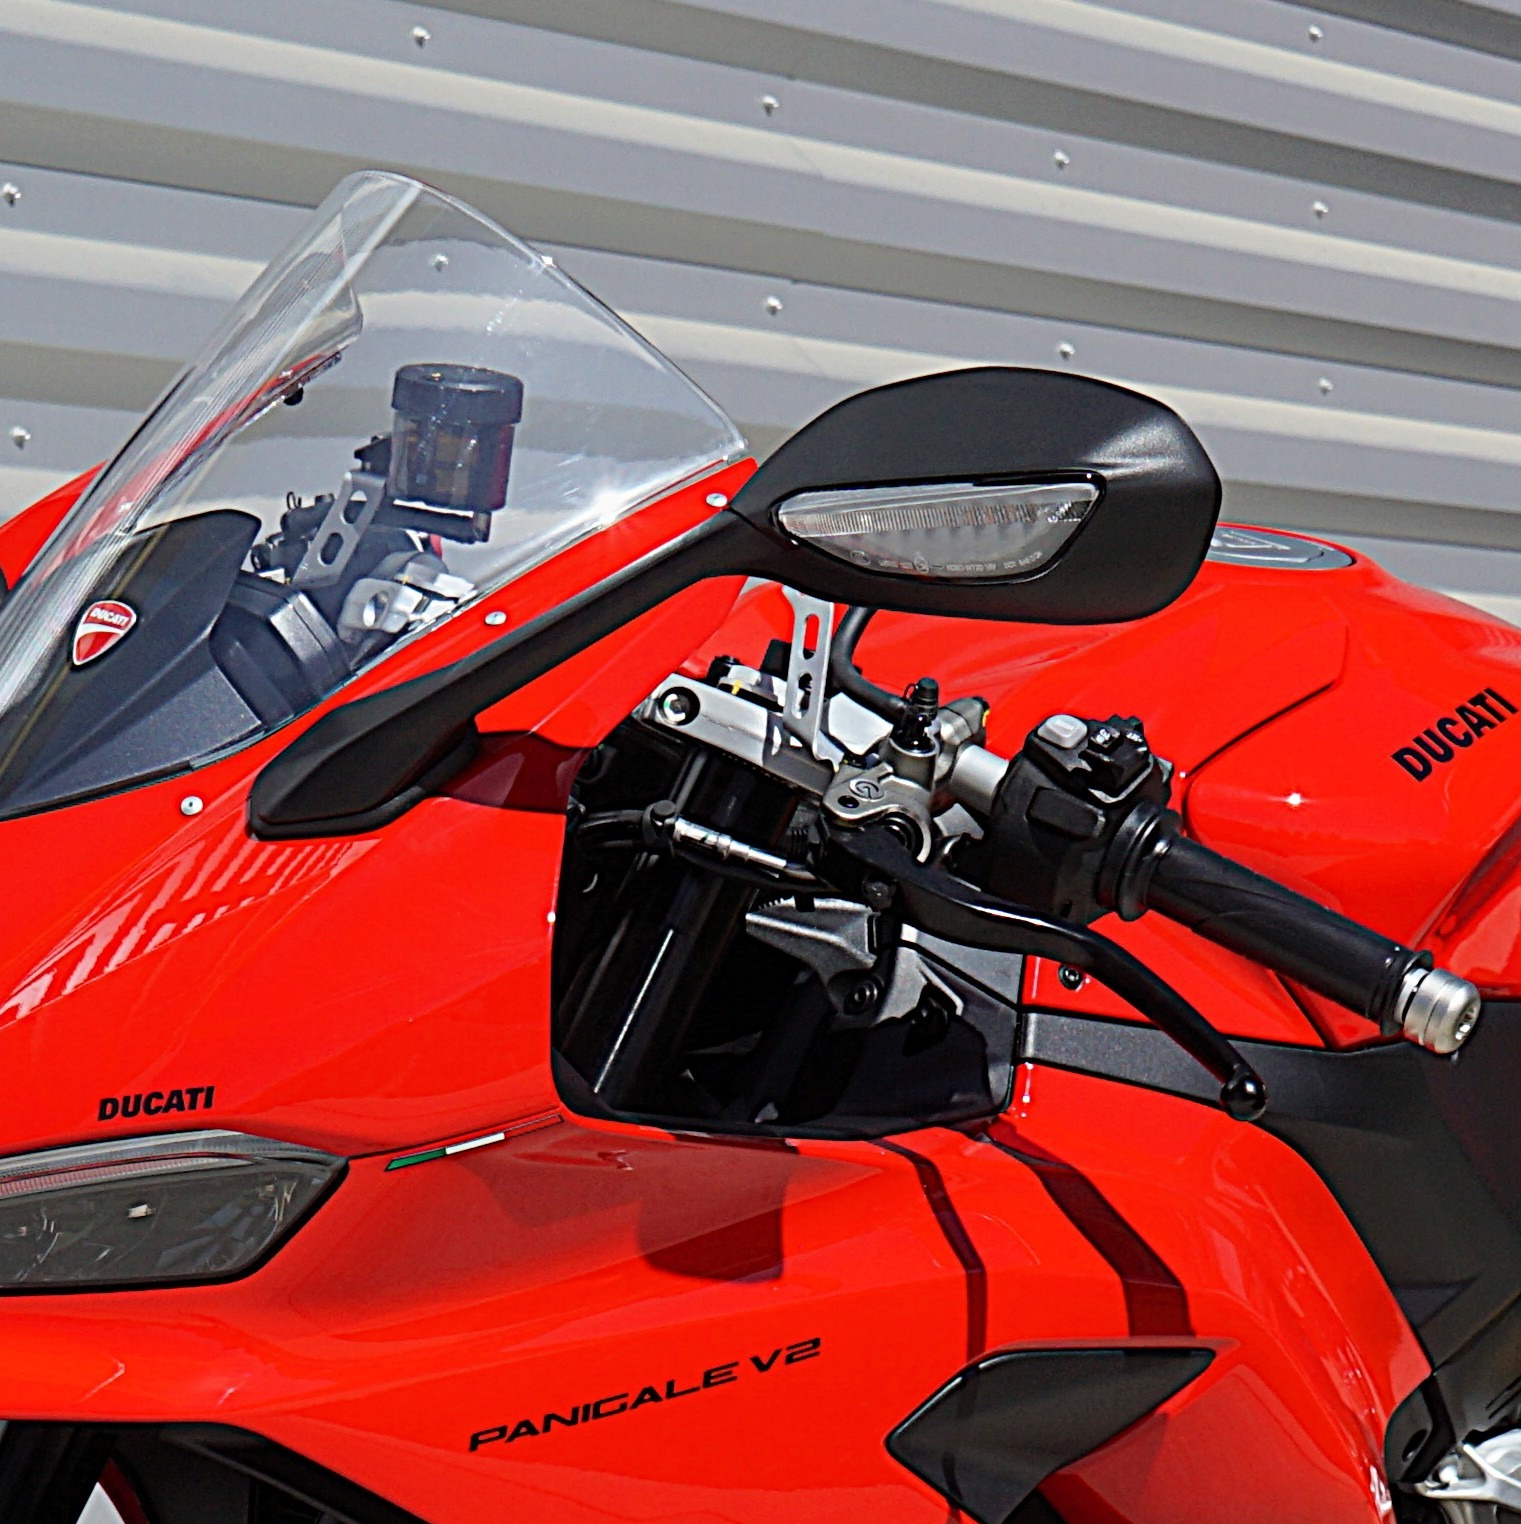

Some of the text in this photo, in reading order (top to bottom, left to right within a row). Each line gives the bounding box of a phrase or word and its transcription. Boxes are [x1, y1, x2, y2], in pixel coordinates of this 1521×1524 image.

[90, 607, 130, 626] DUCATI
[1391, 687, 1519, 782] DUCATI
[98, 1085, 215, 1121] DUCATI
[469, 1337, 821, 1452] PANIGALE V2
